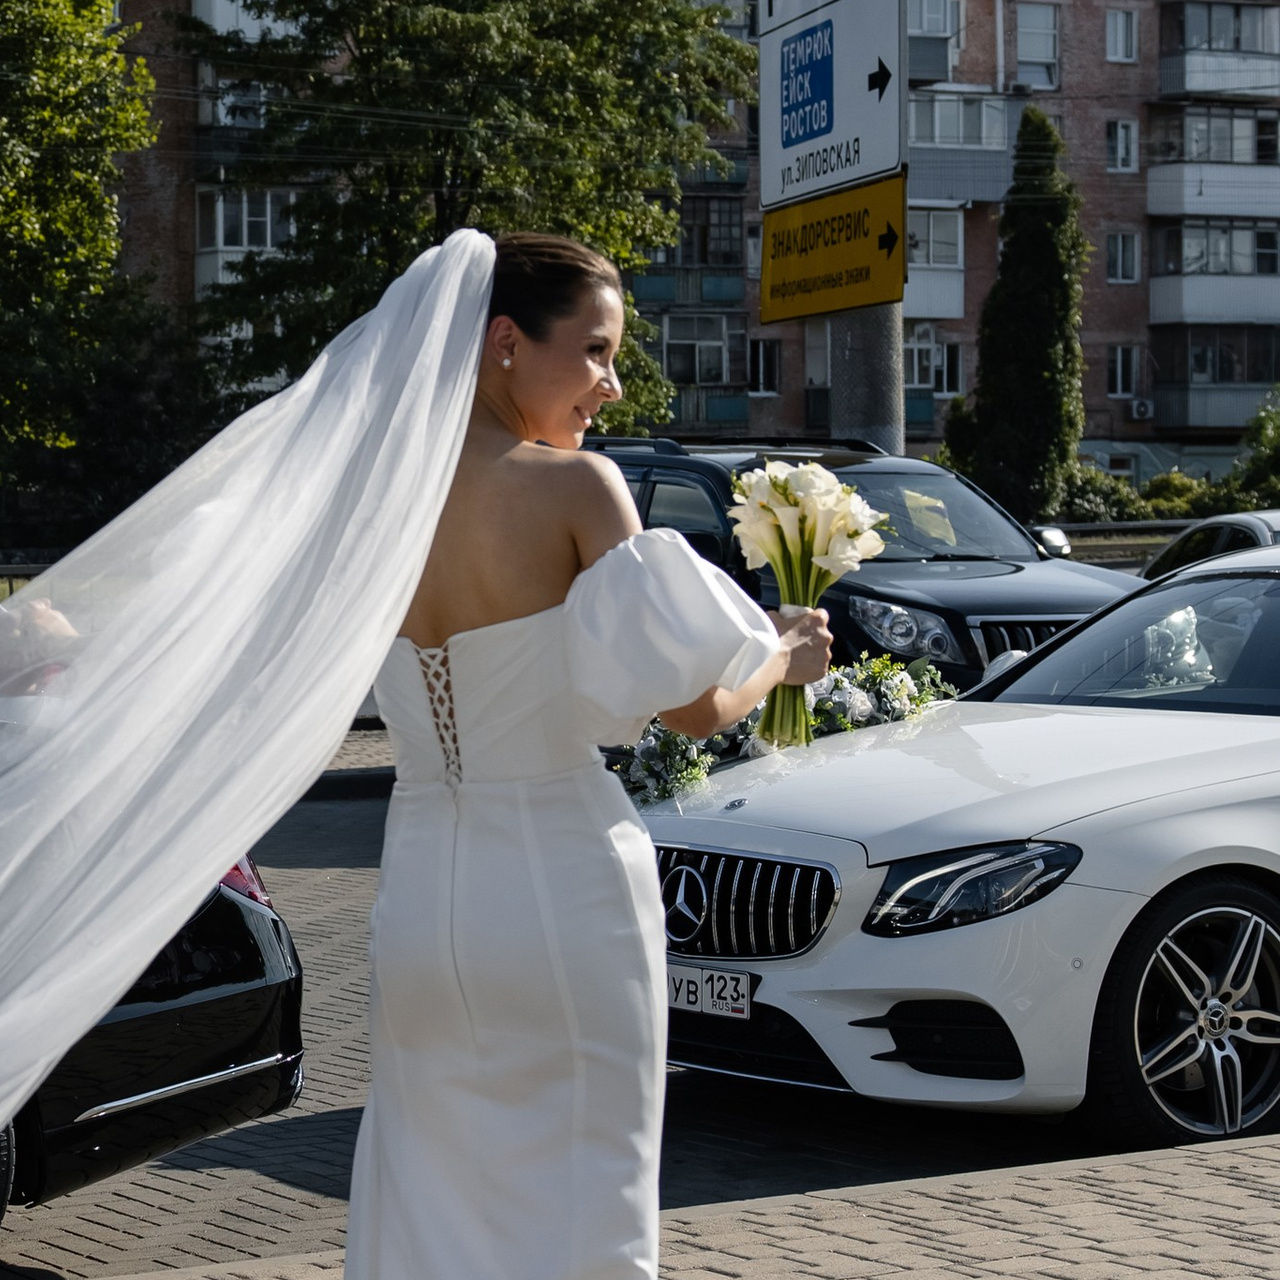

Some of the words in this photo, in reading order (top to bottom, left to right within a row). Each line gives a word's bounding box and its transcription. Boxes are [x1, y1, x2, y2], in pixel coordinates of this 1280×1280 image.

[782, 26, 832, 74] ТЕМРЮК
[782, 70, 812, 108] ЕЙСК
[782, 99, 828, 142] РОСТОВ
[770, 207, 870, 261] ЗНАКДОРСЕРВИС
[844, 265, 871, 286] знаки
[667, 971, 699, 1006] УВ
[704, 973, 741, 1003] 123
[711, 1000, 731, 1012] RUS
